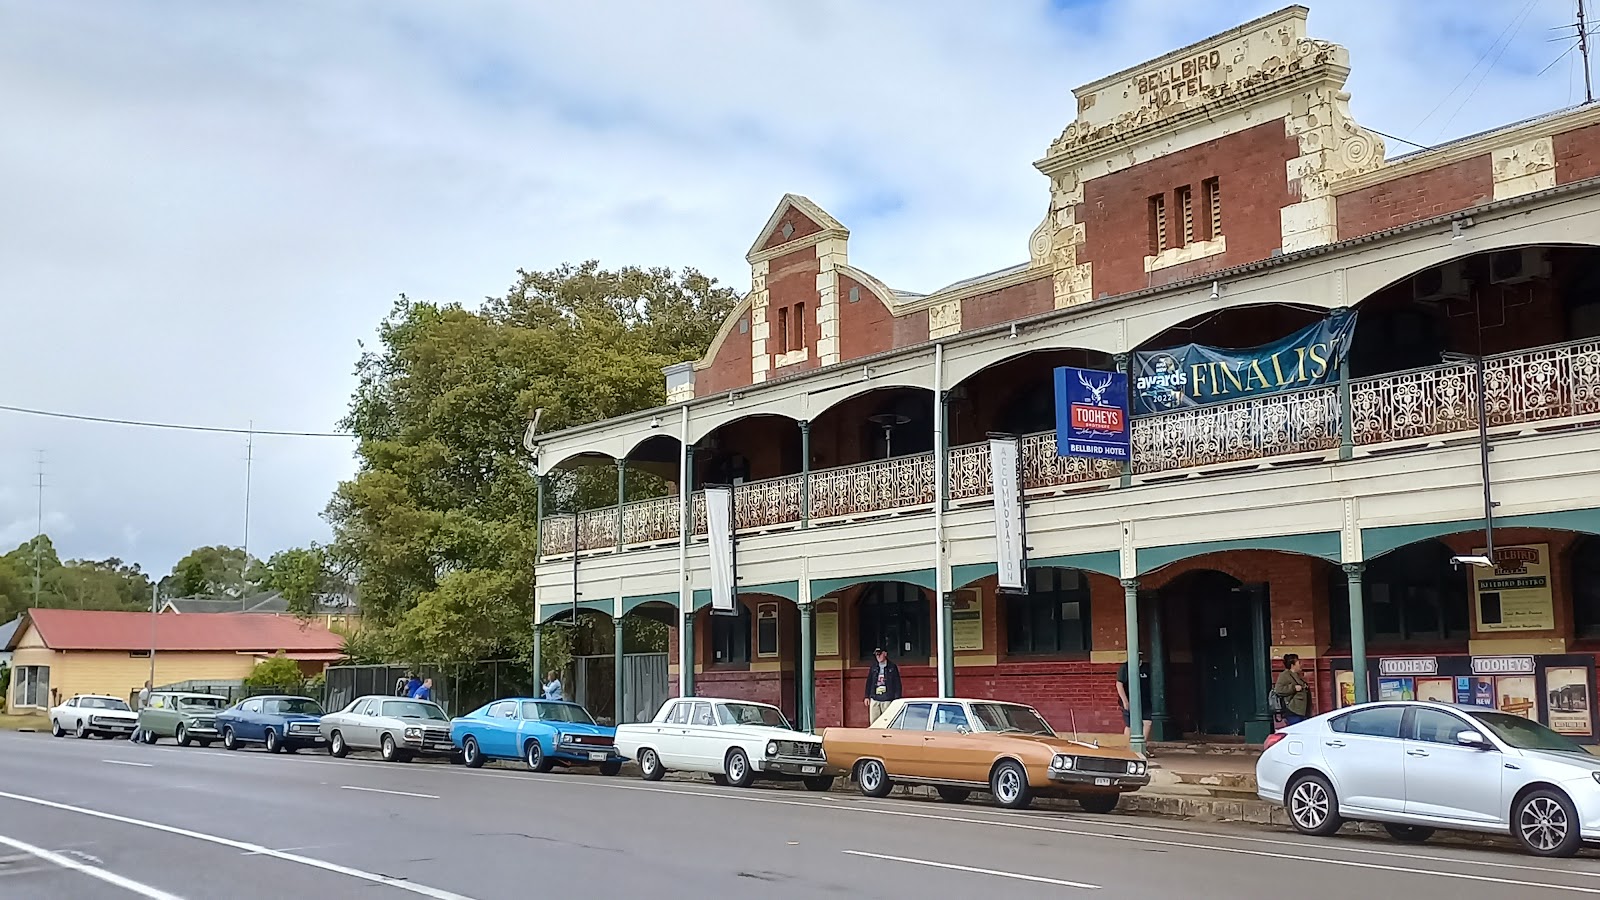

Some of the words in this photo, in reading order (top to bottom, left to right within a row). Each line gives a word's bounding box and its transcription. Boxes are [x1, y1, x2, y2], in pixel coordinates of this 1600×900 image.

[1139, 50, 1220, 95] BELLBIRD
[1148, 75, 1210, 109] HOTEL
[1137, 370, 1187, 389] awards
[1153, 394, 1172, 403] 2022
[1076, 408, 1119, 425] TOOHEYS
[1070, 444, 1103, 453] BELLBIRD
[1105, 447, 1126, 456] HOTEL
[1001, 447, 1013, 582] ACCOMMODATION
[1517, 579, 1545, 587] BISTRO
[1384, 660, 1434, 673] TOOHEYS
[1474, 659, 1531, 671] TOOHEYS
